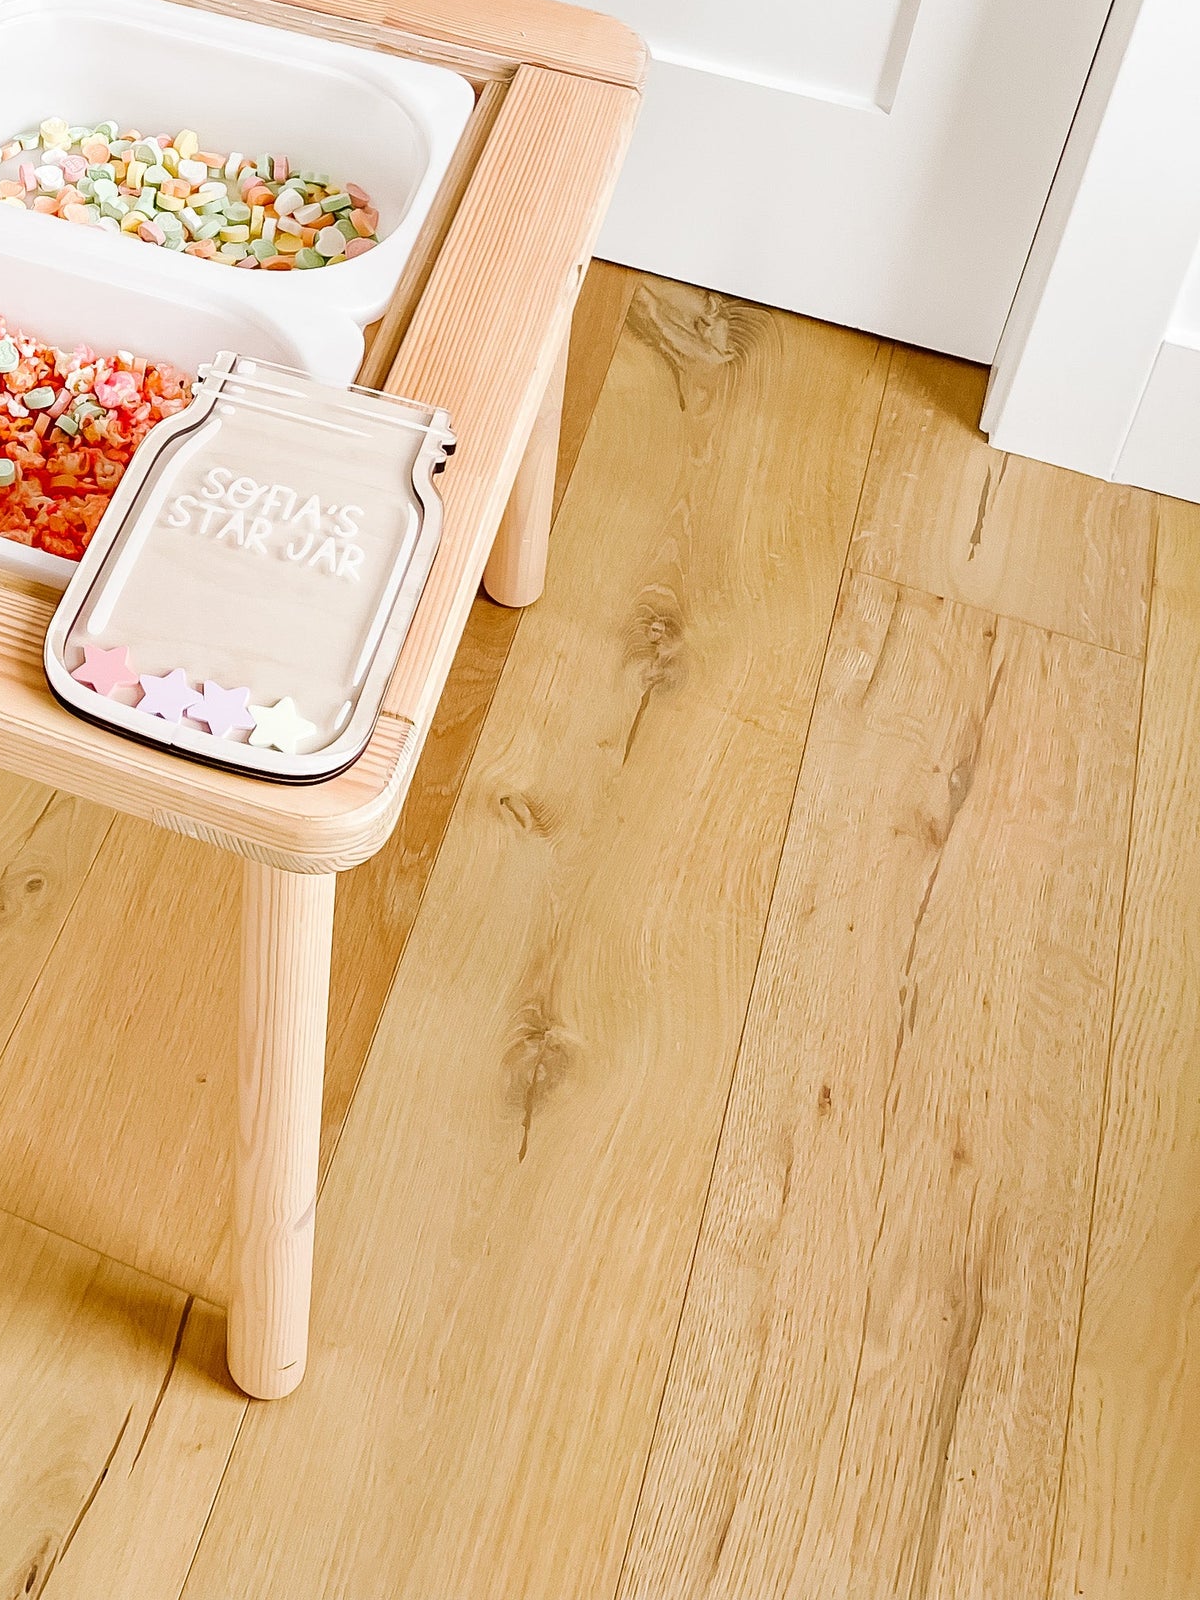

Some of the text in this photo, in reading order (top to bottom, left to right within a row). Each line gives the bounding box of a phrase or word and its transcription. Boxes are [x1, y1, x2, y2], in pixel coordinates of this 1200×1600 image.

[167, 494, 366, 583] STAR JAR
[201, 467, 365, 538] SOFIA'S
